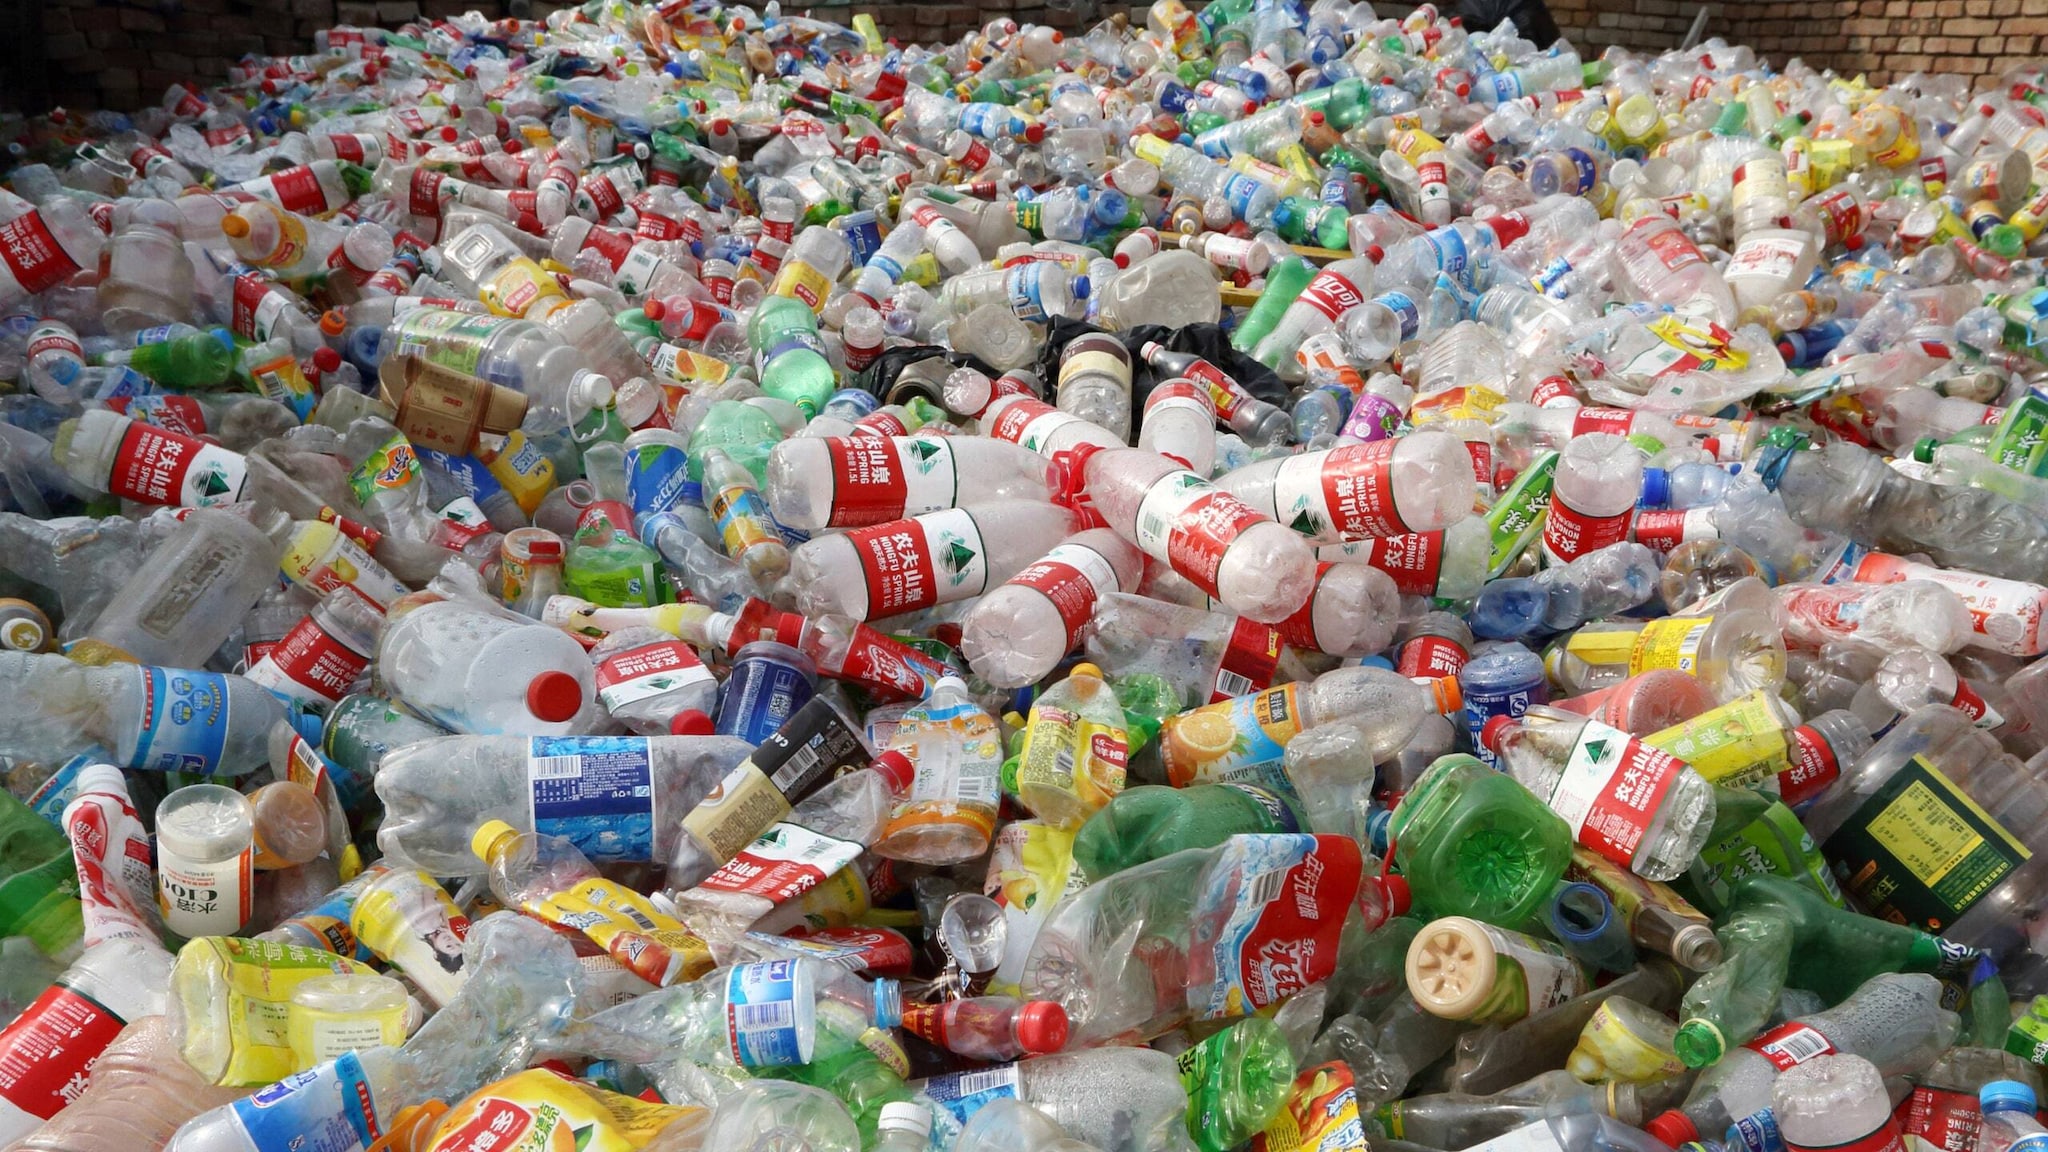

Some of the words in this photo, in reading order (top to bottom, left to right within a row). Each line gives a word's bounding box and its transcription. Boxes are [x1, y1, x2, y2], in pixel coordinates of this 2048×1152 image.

[1580, 407, 1629, 421] Coca-Cola
[144, 435, 163, 464] NONGFU
[149, 440, 183, 499] 农夫山泉
[848, 467, 857, 484] 1.5L
[857, 450, 870, 484] SPRING
[1367, 474, 1376, 493] 1.5L
[1356, 475, 1370, 513] SPRING
[891, 532, 924, 604] 农夫山泉
[1384, 534, 1405, 568] 农夫
[1405, 533, 1418, 570] NONGFU
[879, 536, 900, 572] NONGFU
[892, 574, 903, 607] SPRING
[617, 653, 681, 677] 农夫山泉
[1628, 775, 1651, 808] NONGFU
[176, 901, 218, 916] 水溶
[1302, 938, 1316, 974] 统一
